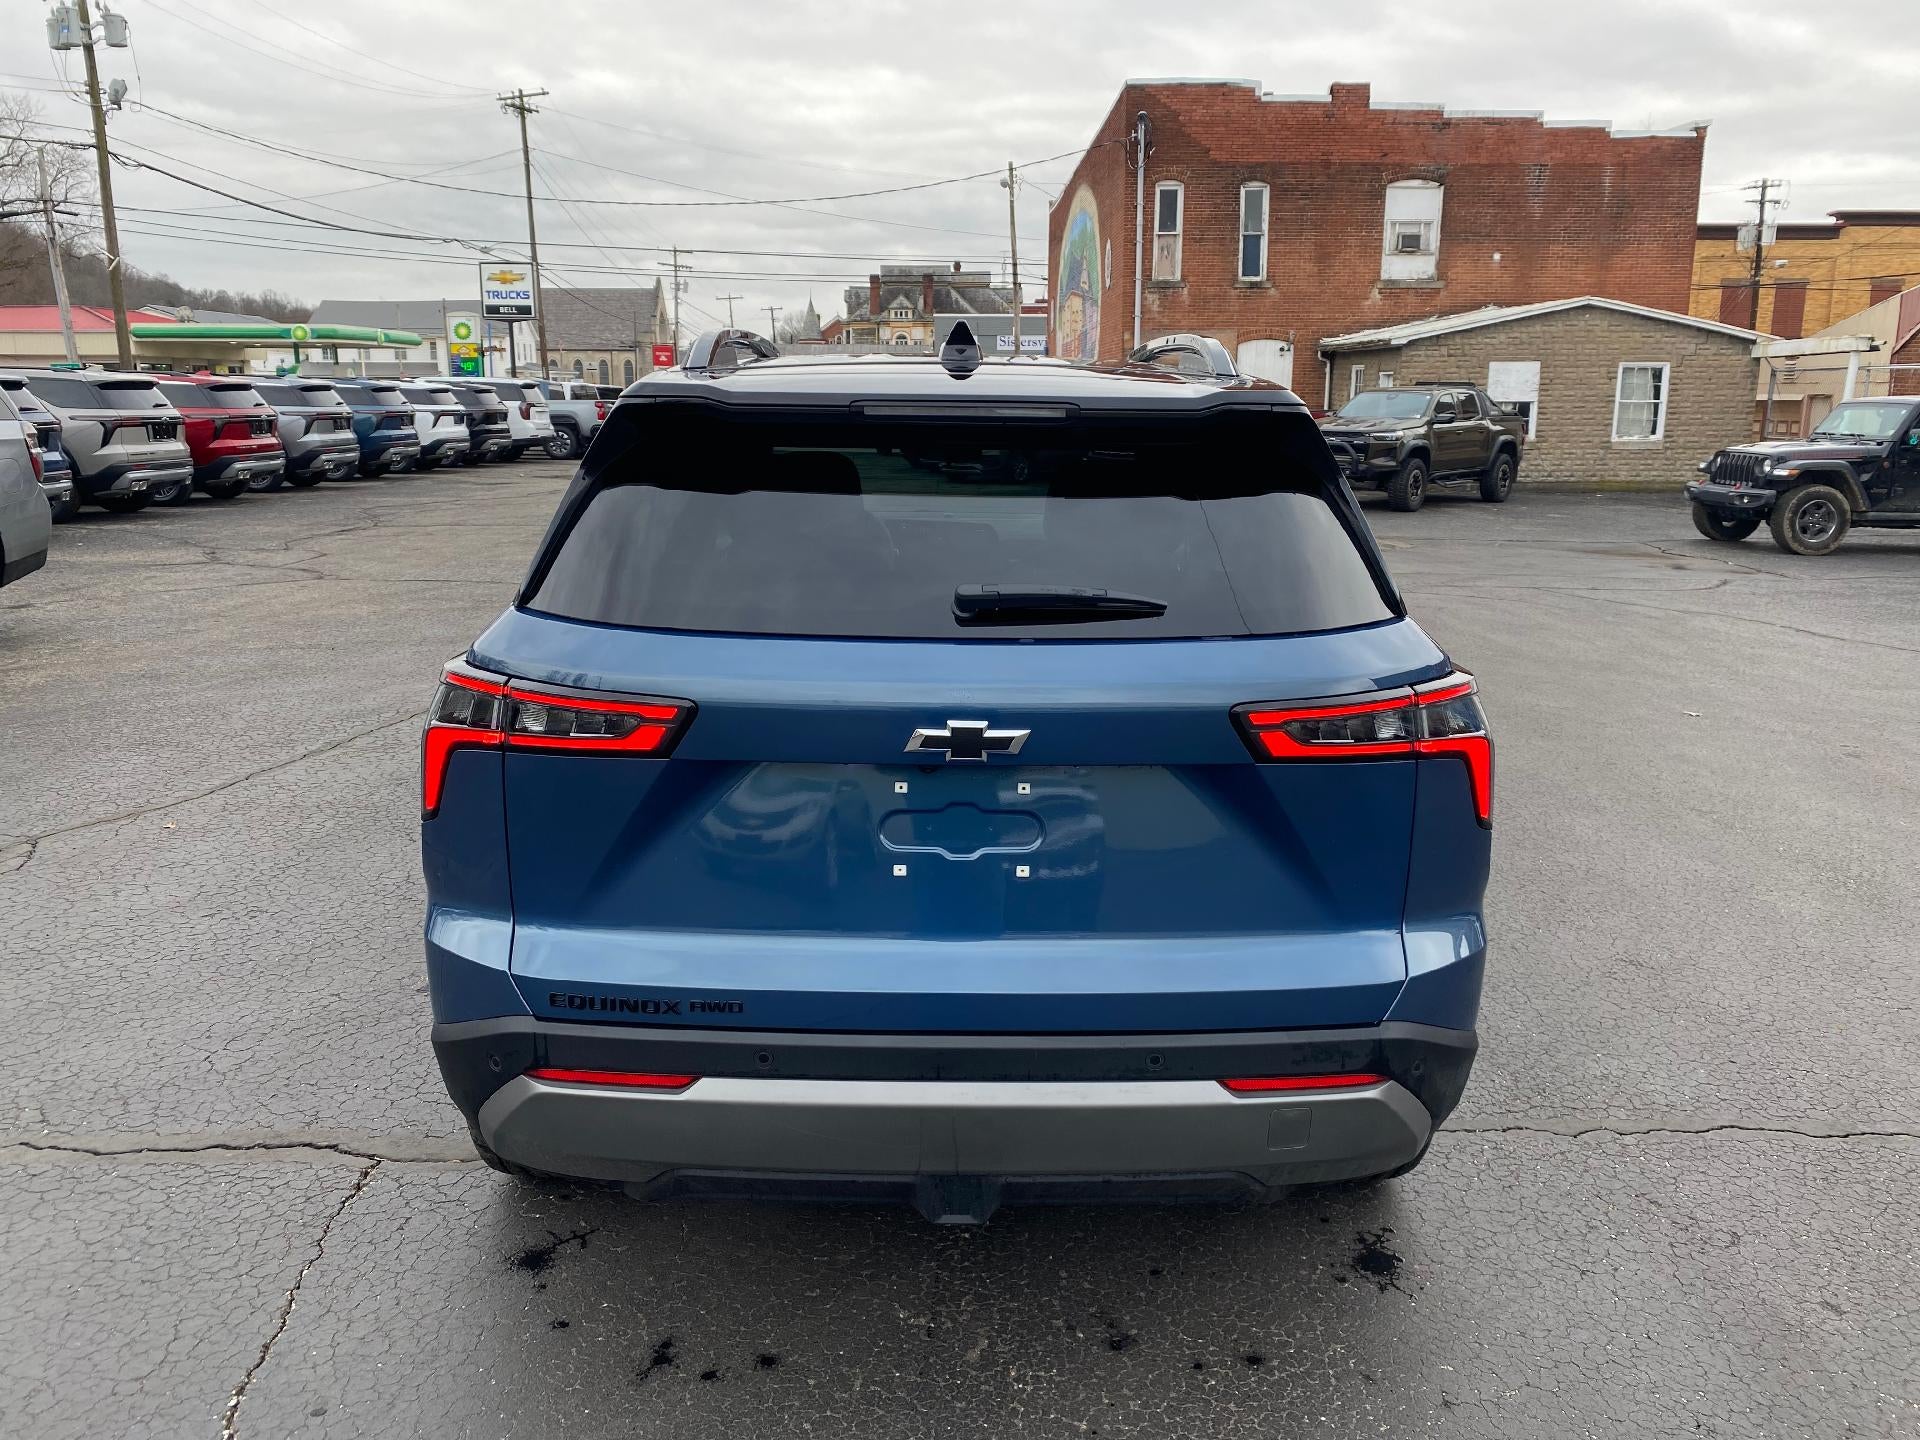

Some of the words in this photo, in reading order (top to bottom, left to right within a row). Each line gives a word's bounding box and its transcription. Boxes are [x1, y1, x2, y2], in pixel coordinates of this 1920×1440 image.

[485, 290, 530, 300] TRUCKS
[999, 336, 1048, 347] Sisersvi
[548, 991, 682, 1015] EQUINOX
[689, 999, 744, 1014] AWD
